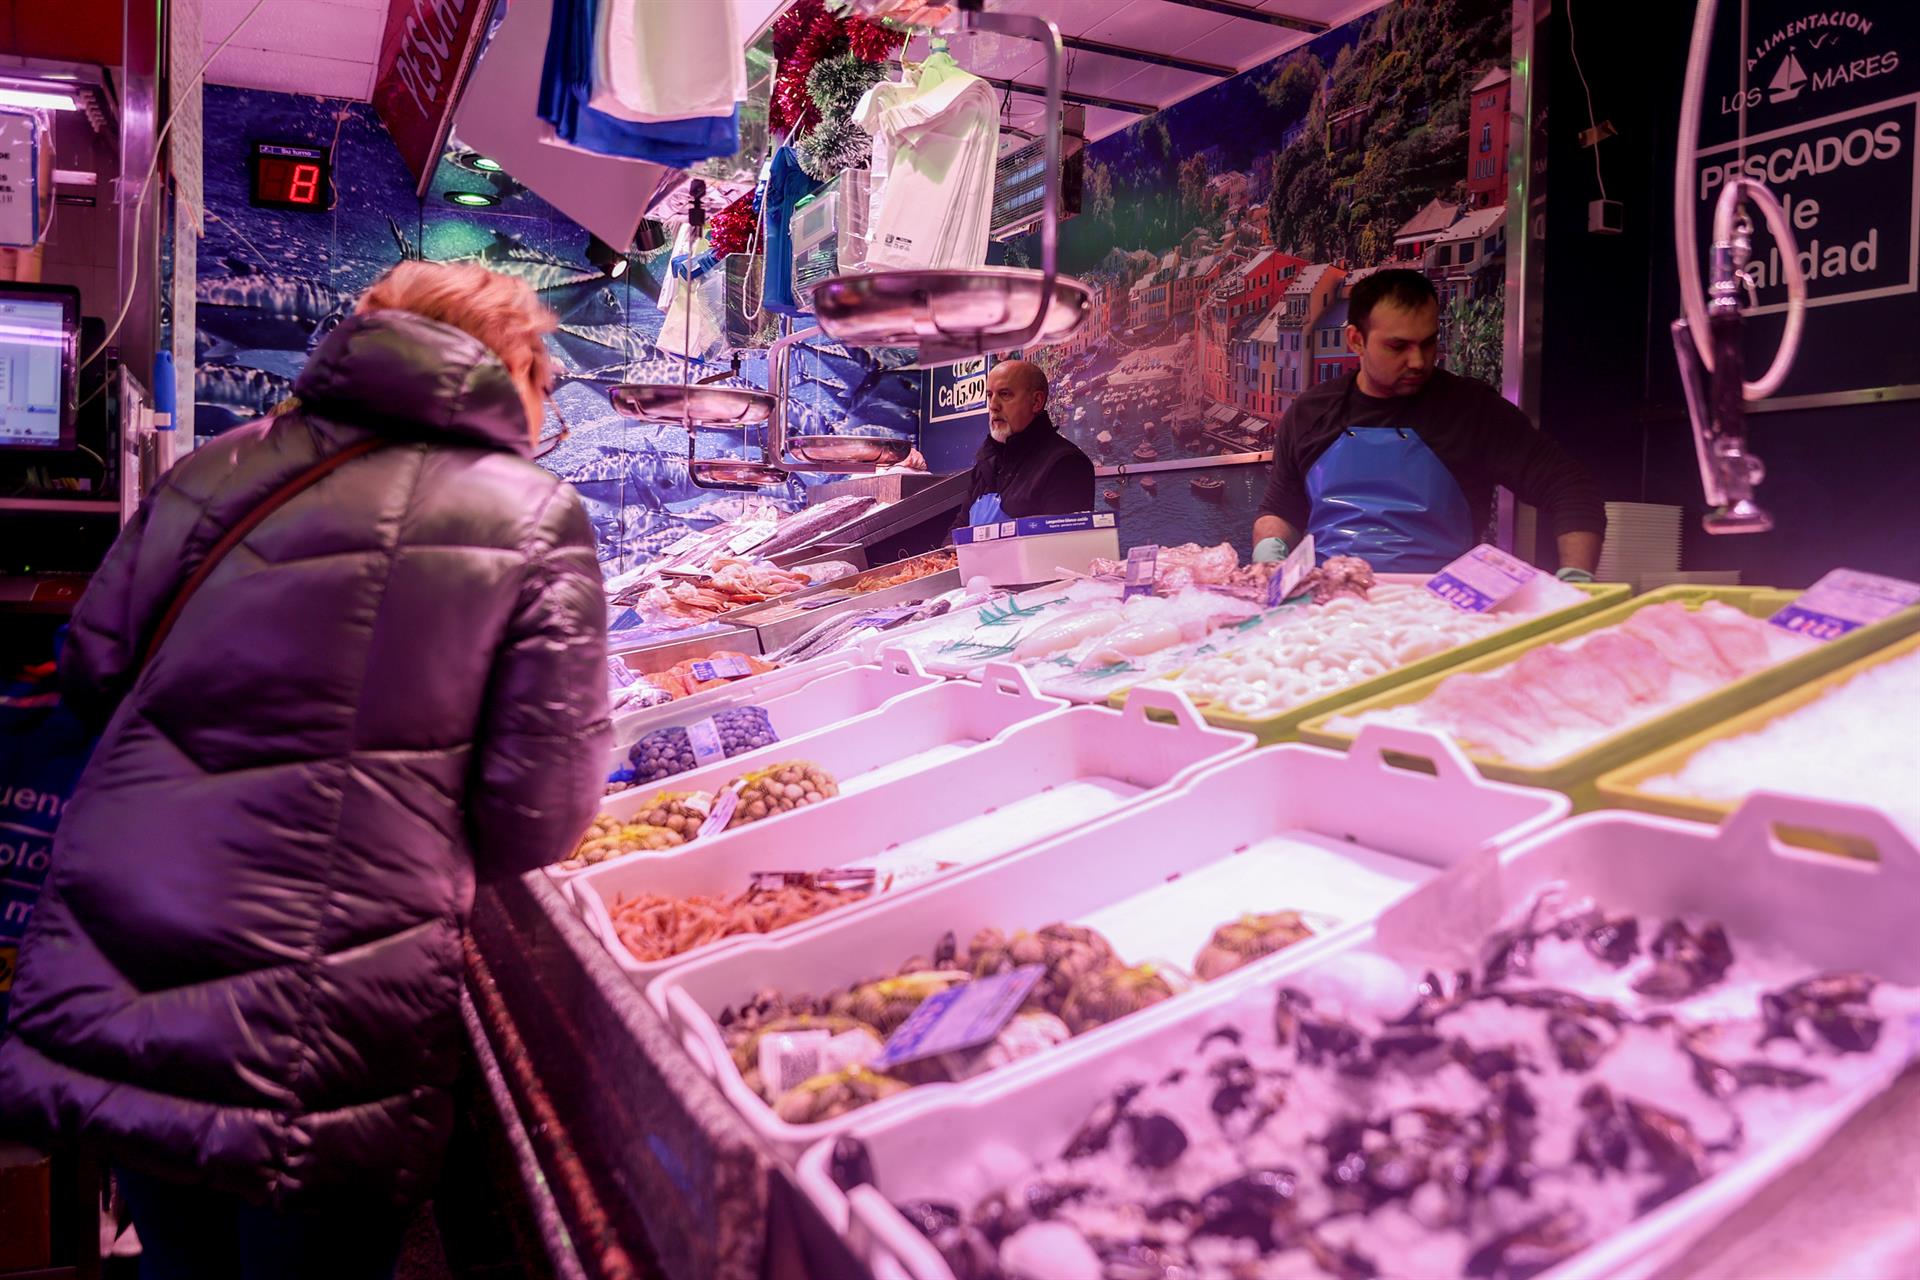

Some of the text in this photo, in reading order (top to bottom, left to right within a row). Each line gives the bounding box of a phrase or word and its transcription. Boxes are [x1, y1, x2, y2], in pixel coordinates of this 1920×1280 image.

[396, 0, 465, 119] PESCA
[1747, 11, 1872, 72] ALIMENTACION
[1721, 51, 1899, 114] LOS MARES
[289, 164, 319, 203] 8
[1741, 228, 1878, 289] aldad
